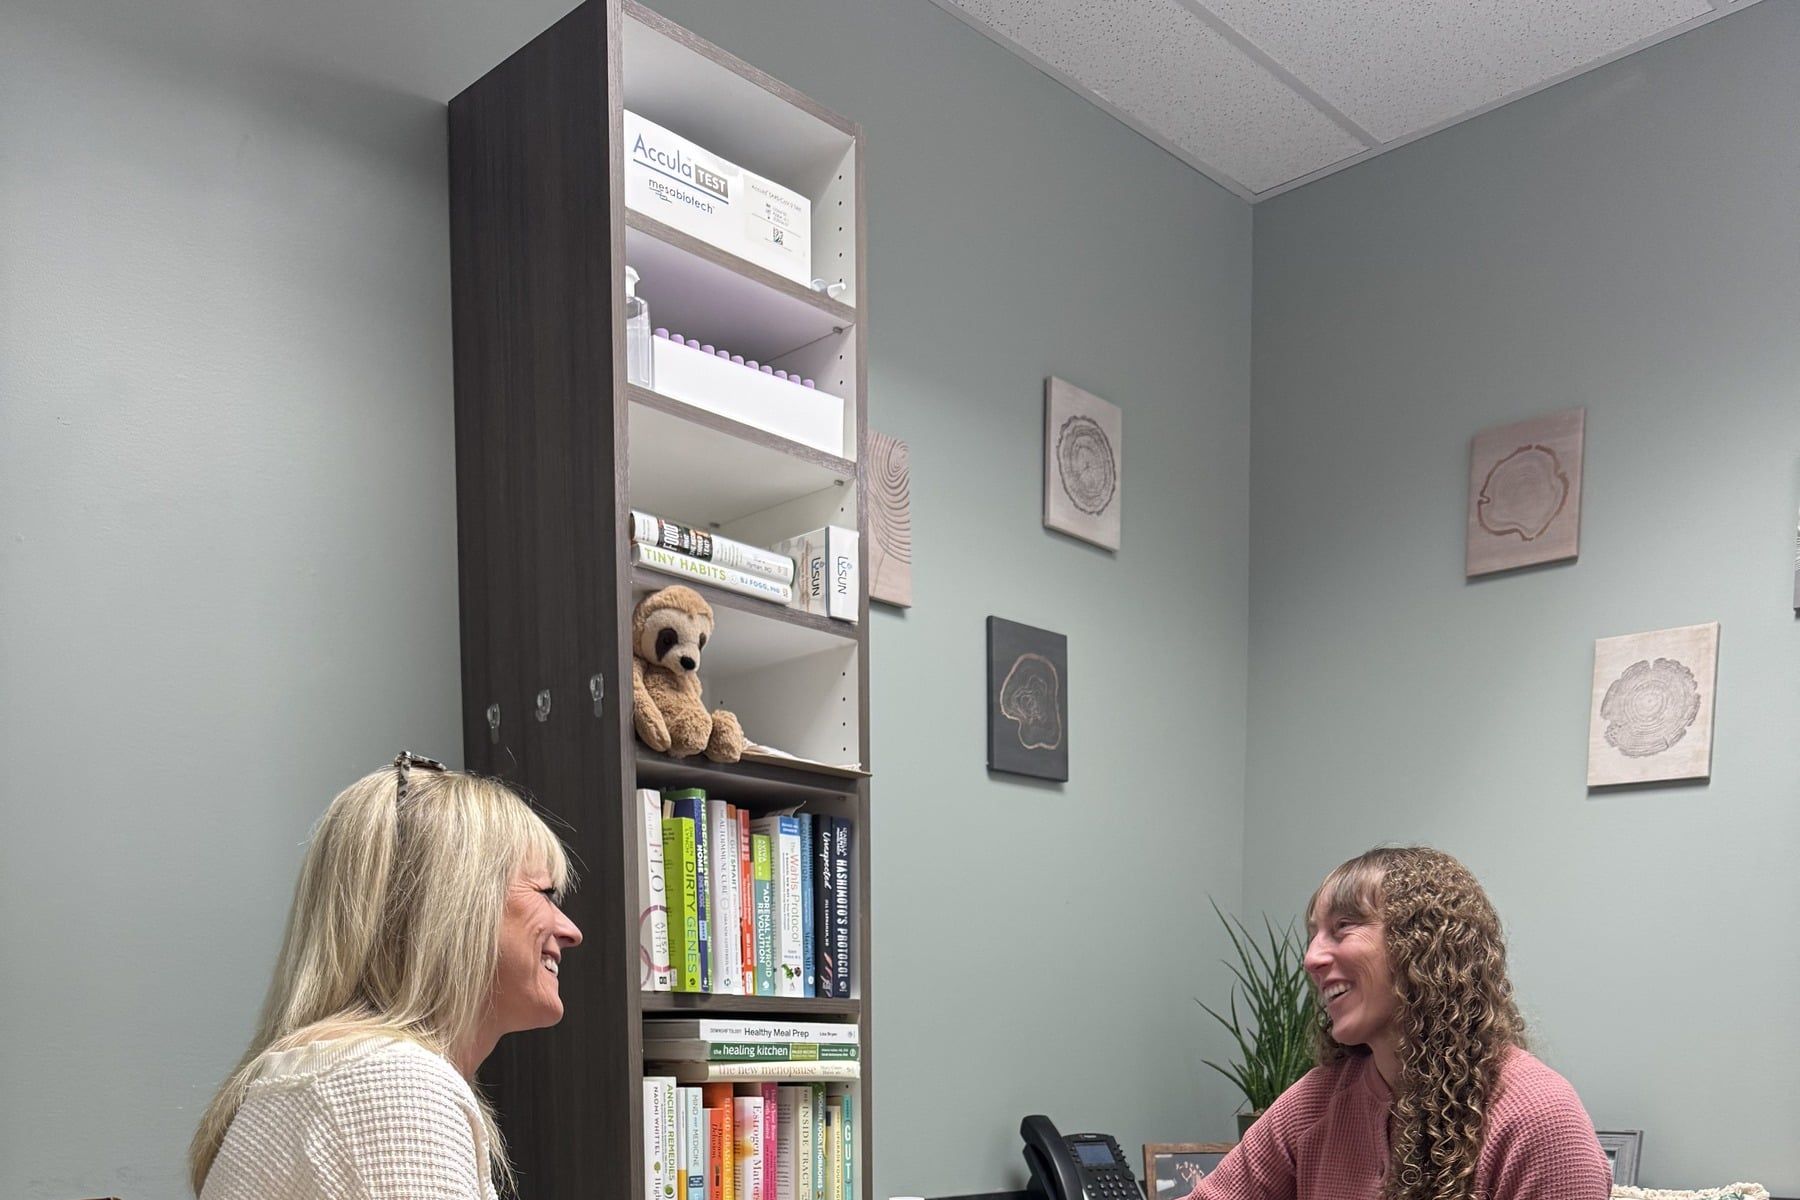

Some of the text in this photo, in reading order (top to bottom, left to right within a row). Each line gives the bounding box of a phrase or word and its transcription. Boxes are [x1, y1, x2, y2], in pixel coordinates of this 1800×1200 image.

[633, 133, 727, 194] Accula TEST
[648, 178, 713, 215] mesabiotech
[663, 523, 679, 551] FOOD
[644, 547, 727, 581] TINY HABITS
[649, 843, 664, 893] FLO
[790, 854, 799, 890] Wahls
[819, 832, 832, 890] Unexpected
[685, 861, 698, 973] DIRTY GENES
[763, 889, 771, 933] ADRENAL
[791, 894, 801, 943] Protocol
[836, 860, 848, 978] HASHIMOTO'S PROTOCOL
[723, 1044, 756, 1058] healing
[756, 1045, 788, 1056] kitchen
[744, 1027, 772, 1038] Healthy
[773, 1028, 791, 1037] Meal
[792, 1029, 810, 1039] Prep
[738, 1066, 758, 1075] new
[761, 1065, 817, 1077] menopause
[667, 1084, 675, 1128] ANCIENT
[692, 1129, 700, 1167] MEDICINE
[750, 1105, 762, 1156] Estrogen
[844, 1124, 852, 1180] GUT
[653, 1178, 661, 1200] High
